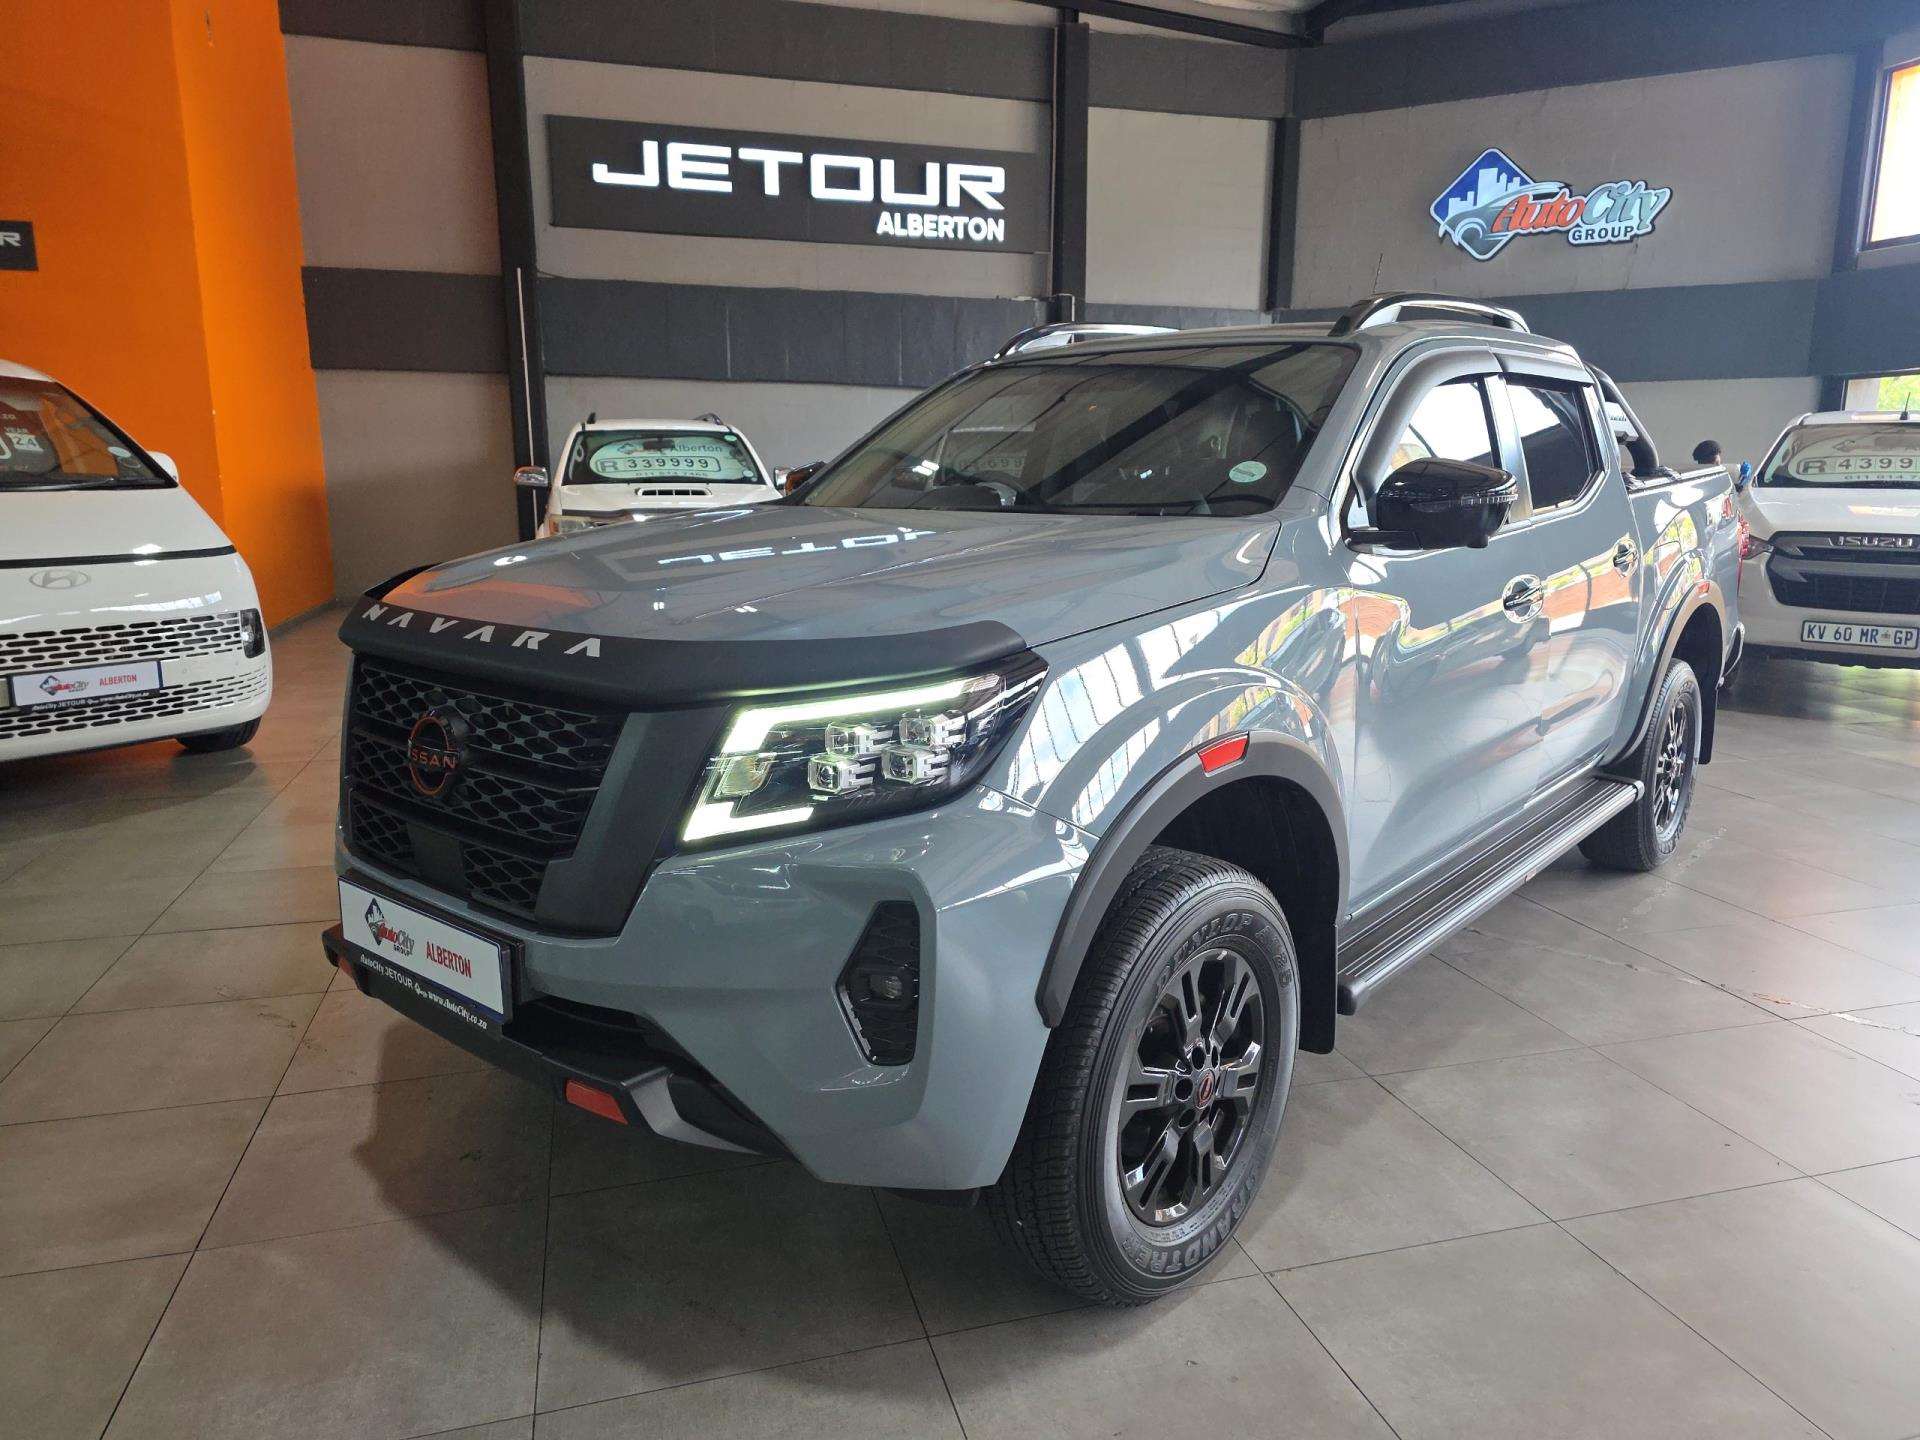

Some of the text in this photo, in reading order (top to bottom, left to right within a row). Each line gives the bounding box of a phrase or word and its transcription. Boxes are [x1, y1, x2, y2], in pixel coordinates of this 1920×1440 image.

[592, 139, 1006, 210] JETOUR
[1491, 183, 1665, 231] AutoCity
[876, 210, 1005, 241] ALBERTON
[1571, 225, 1635, 242] GROUP
[627, 458, 709, 469] 339999
[1838, 535, 1914, 549] ISUZU
[362, 603, 602, 658] NAVARA
[1807, 624, 1914, 646] KV 60 MR GP
[100, 675, 137, 686] ALBERTON
[58, 698, 86, 709] JETOUR
[426, 942, 472, 978] ALBERTON
[385, 964, 414, 990] JETOUR
